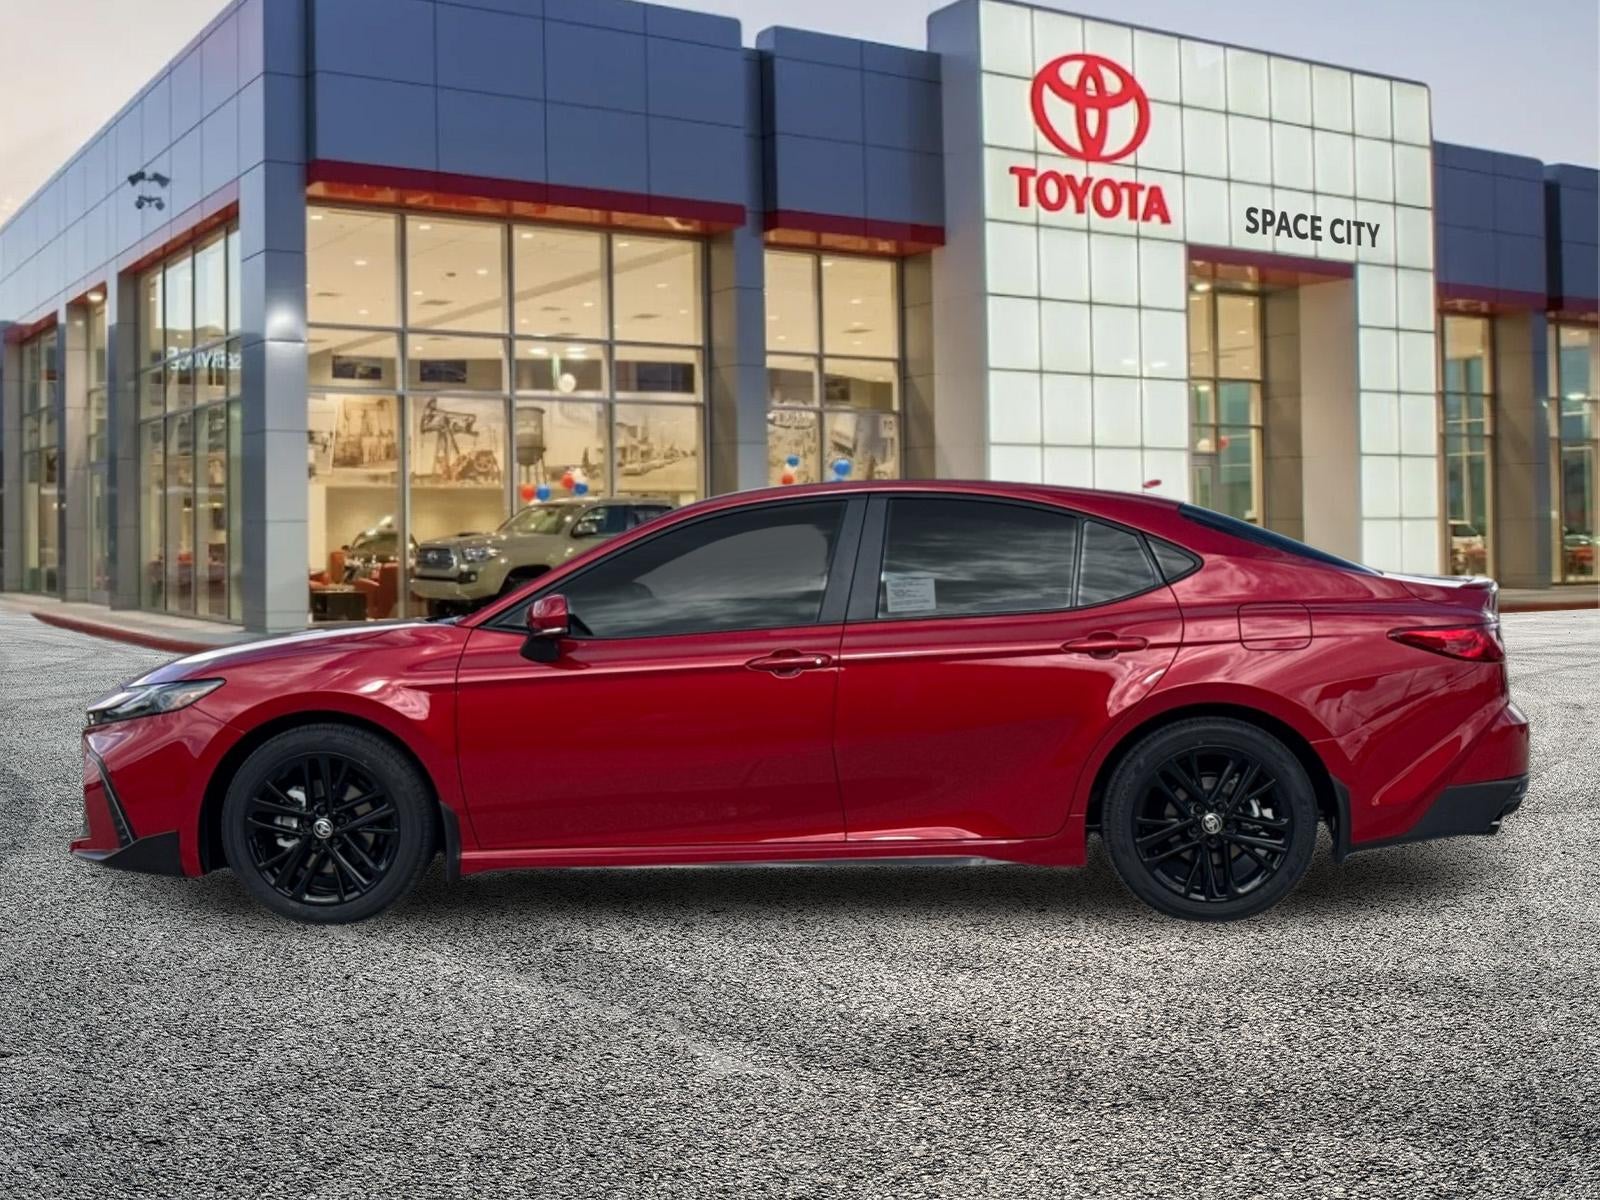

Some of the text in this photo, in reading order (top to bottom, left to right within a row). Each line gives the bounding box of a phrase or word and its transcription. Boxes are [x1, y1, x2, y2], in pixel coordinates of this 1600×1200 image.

[1009, 166, 1171, 225] TOYOTA
[1245, 206, 1381, 248] SPACE CITY
